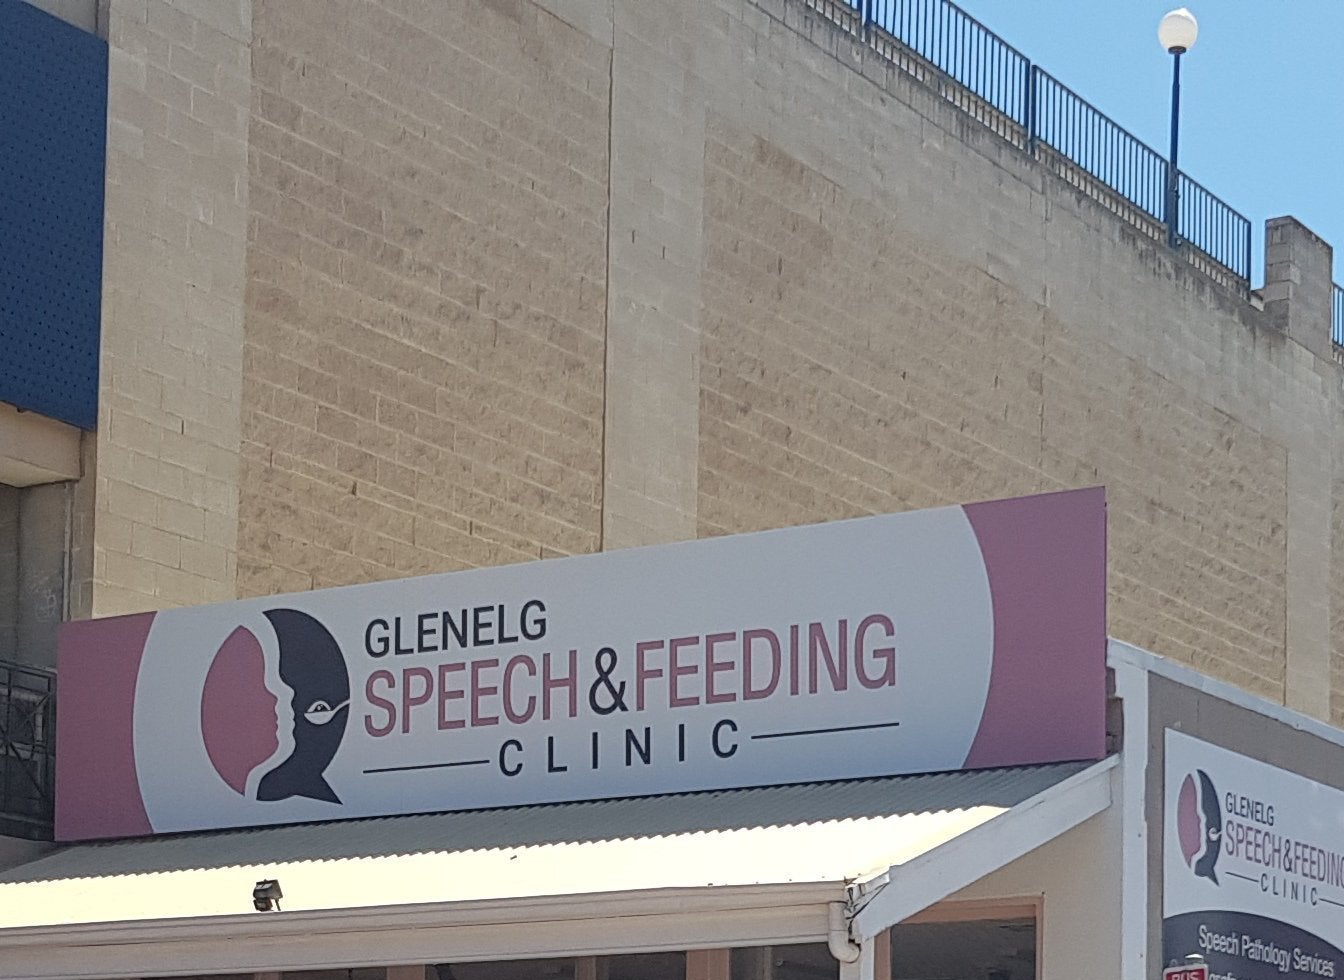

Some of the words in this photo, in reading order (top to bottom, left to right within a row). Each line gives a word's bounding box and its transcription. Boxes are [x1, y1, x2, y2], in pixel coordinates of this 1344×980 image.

[364, 599, 547, 658] GLENELG
[498, 719, 738, 777] CLINIC
[1225, 792, 1274, 826] GLENELG
[1260, 873, 1318, 906] CLINIC
[1198, 925, 1239, 954] Speech
[1241, 935, 1291, 973] Pathology
[1293, 948, 1335, 978] Services
